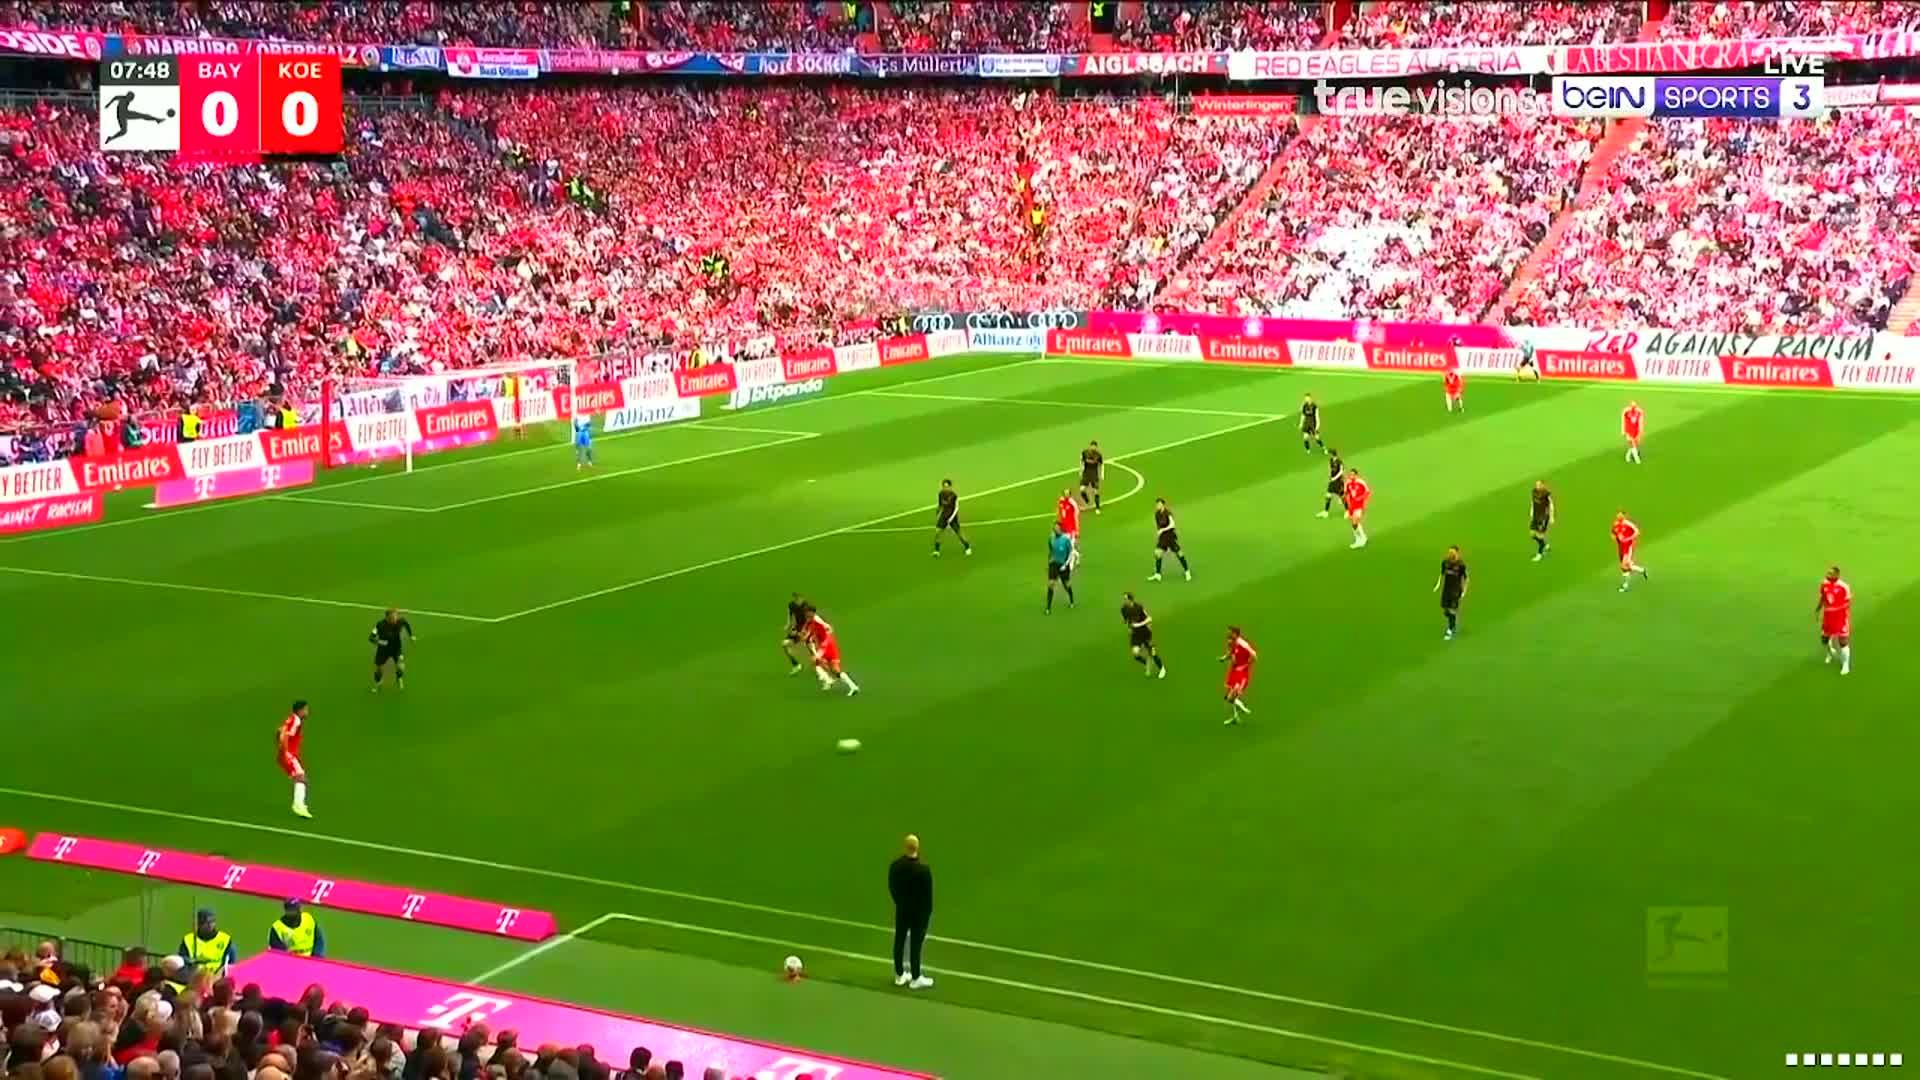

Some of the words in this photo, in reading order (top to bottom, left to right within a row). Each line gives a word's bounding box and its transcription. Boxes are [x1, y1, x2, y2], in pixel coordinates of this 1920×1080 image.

[1254, 56, 1301, 77] RED
[1307, 54, 1400, 75] EAGLES
[972, 333, 1023, 347] Allianz
[1055, 334, 1122, 352] Emirates
[1210, 340, 1280, 360] Emirates
[1645, 331, 1759, 357] AGAINST
[786, 357, 831, 377] Emirates
[1373, 348, 1447, 368] Emirates
[1545, 354, 1626, 376] Emirates
[1732, 360, 1820, 382] Emirates
[680, 372, 729, 393] Emirates
[426, 410, 489, 435] Emirates
[612, 405, 675, 427] Allianz
[14, 466, 62, 496] BETTER
[84, 456, 171, 488] Emirates
